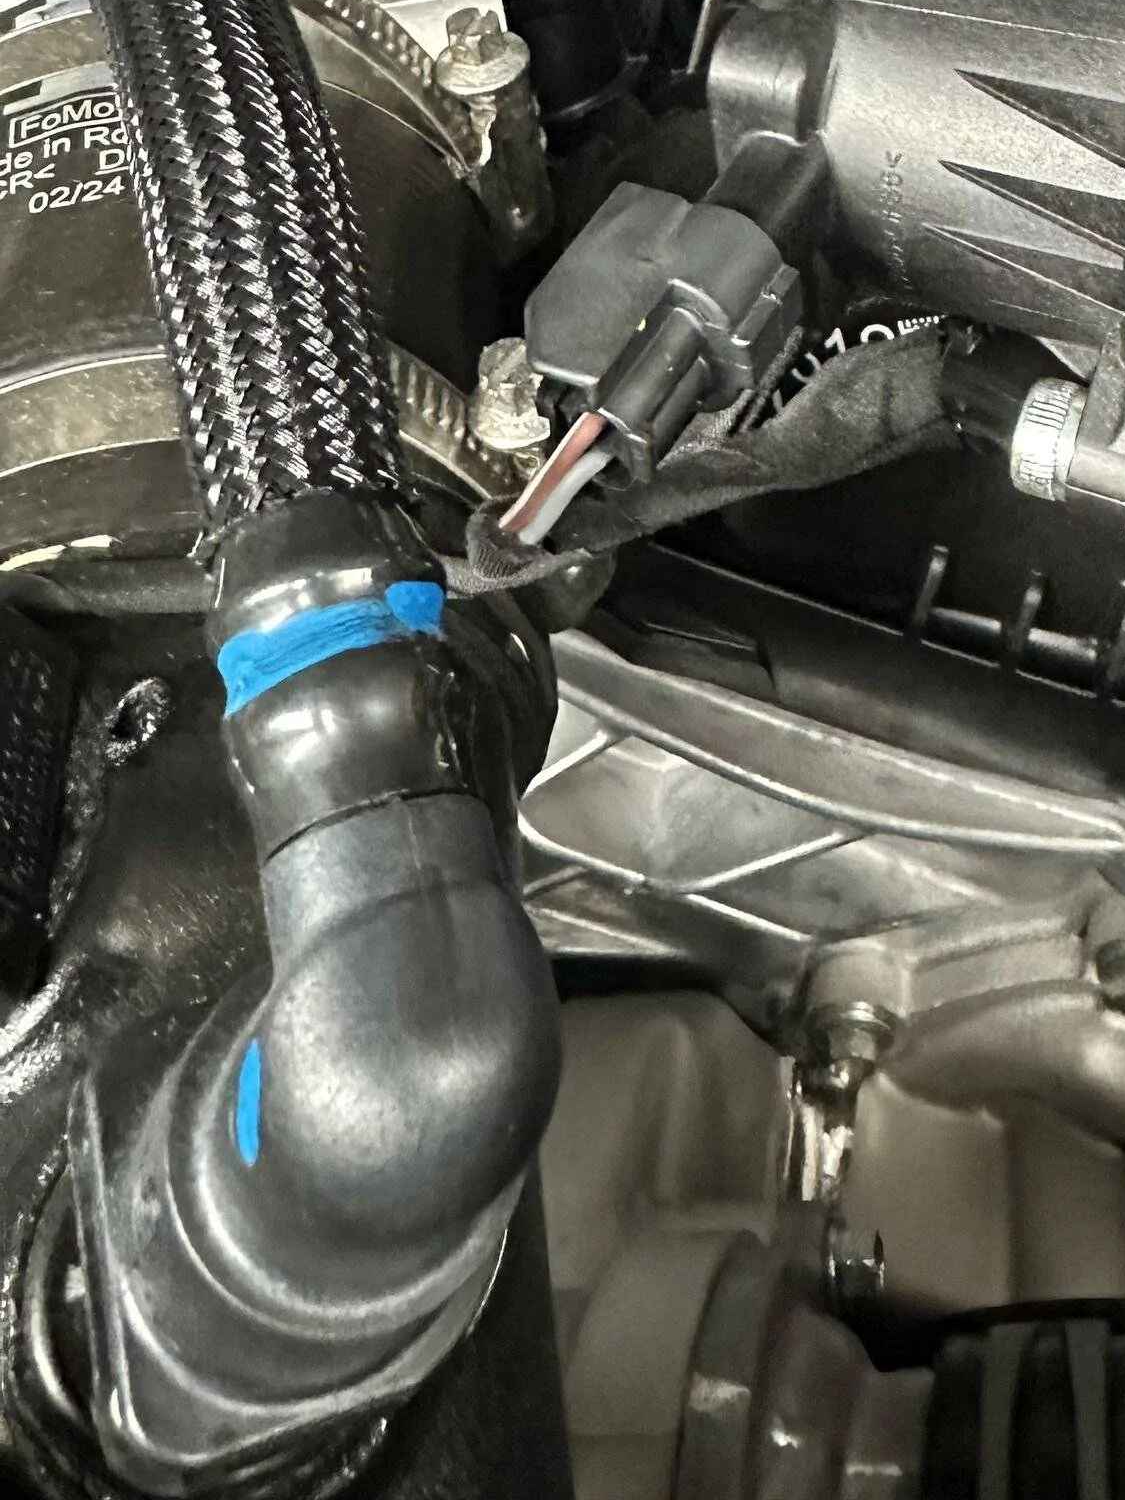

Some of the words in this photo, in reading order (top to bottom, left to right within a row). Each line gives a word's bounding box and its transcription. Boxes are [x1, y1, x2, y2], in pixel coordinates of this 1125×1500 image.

[20, 99, 115, 139] FoMo
[0, 152, 34, 177] de
[43, 137, 71, 159] in
[28, 175, 126, 214] 02/24
